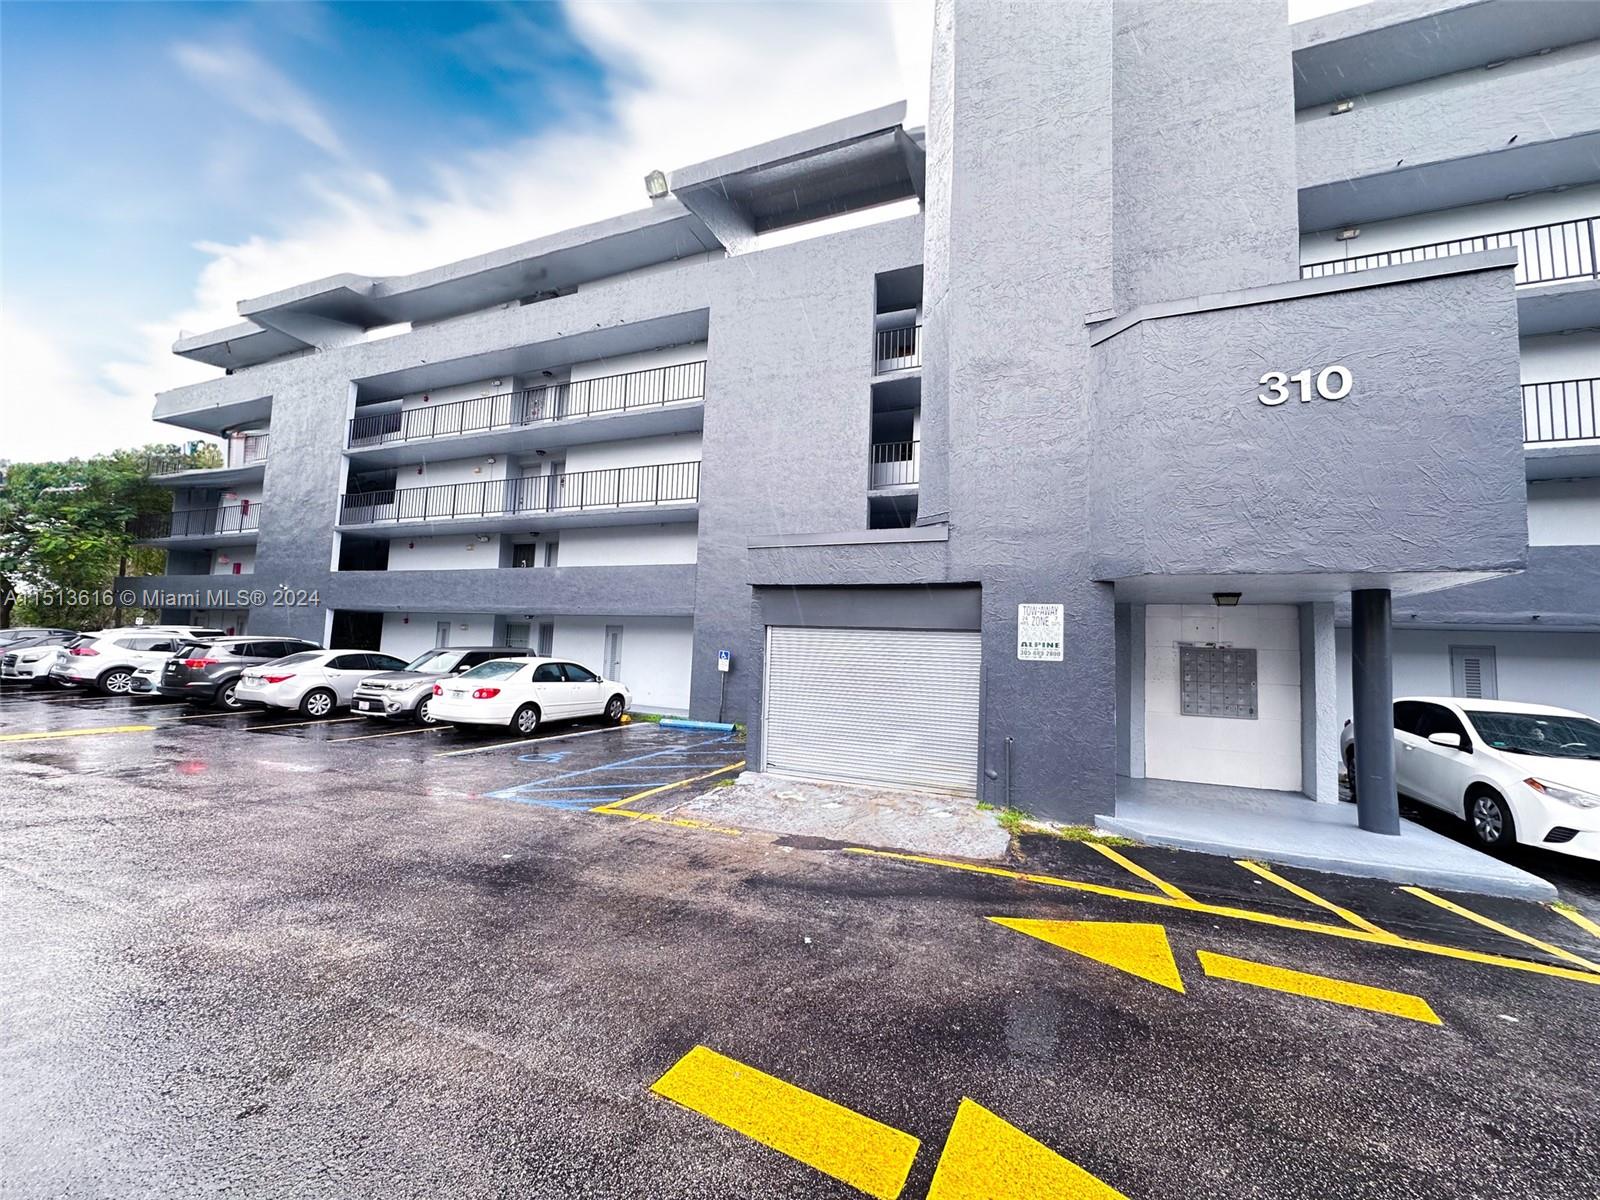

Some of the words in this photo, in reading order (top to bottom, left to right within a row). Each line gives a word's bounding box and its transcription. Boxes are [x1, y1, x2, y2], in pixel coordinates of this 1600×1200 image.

[1258, 365, 1352, 406] 310
[1023, 605, 1060, 616] TOW-AWAY
[1031, 615, 1049, 626] ZONE
